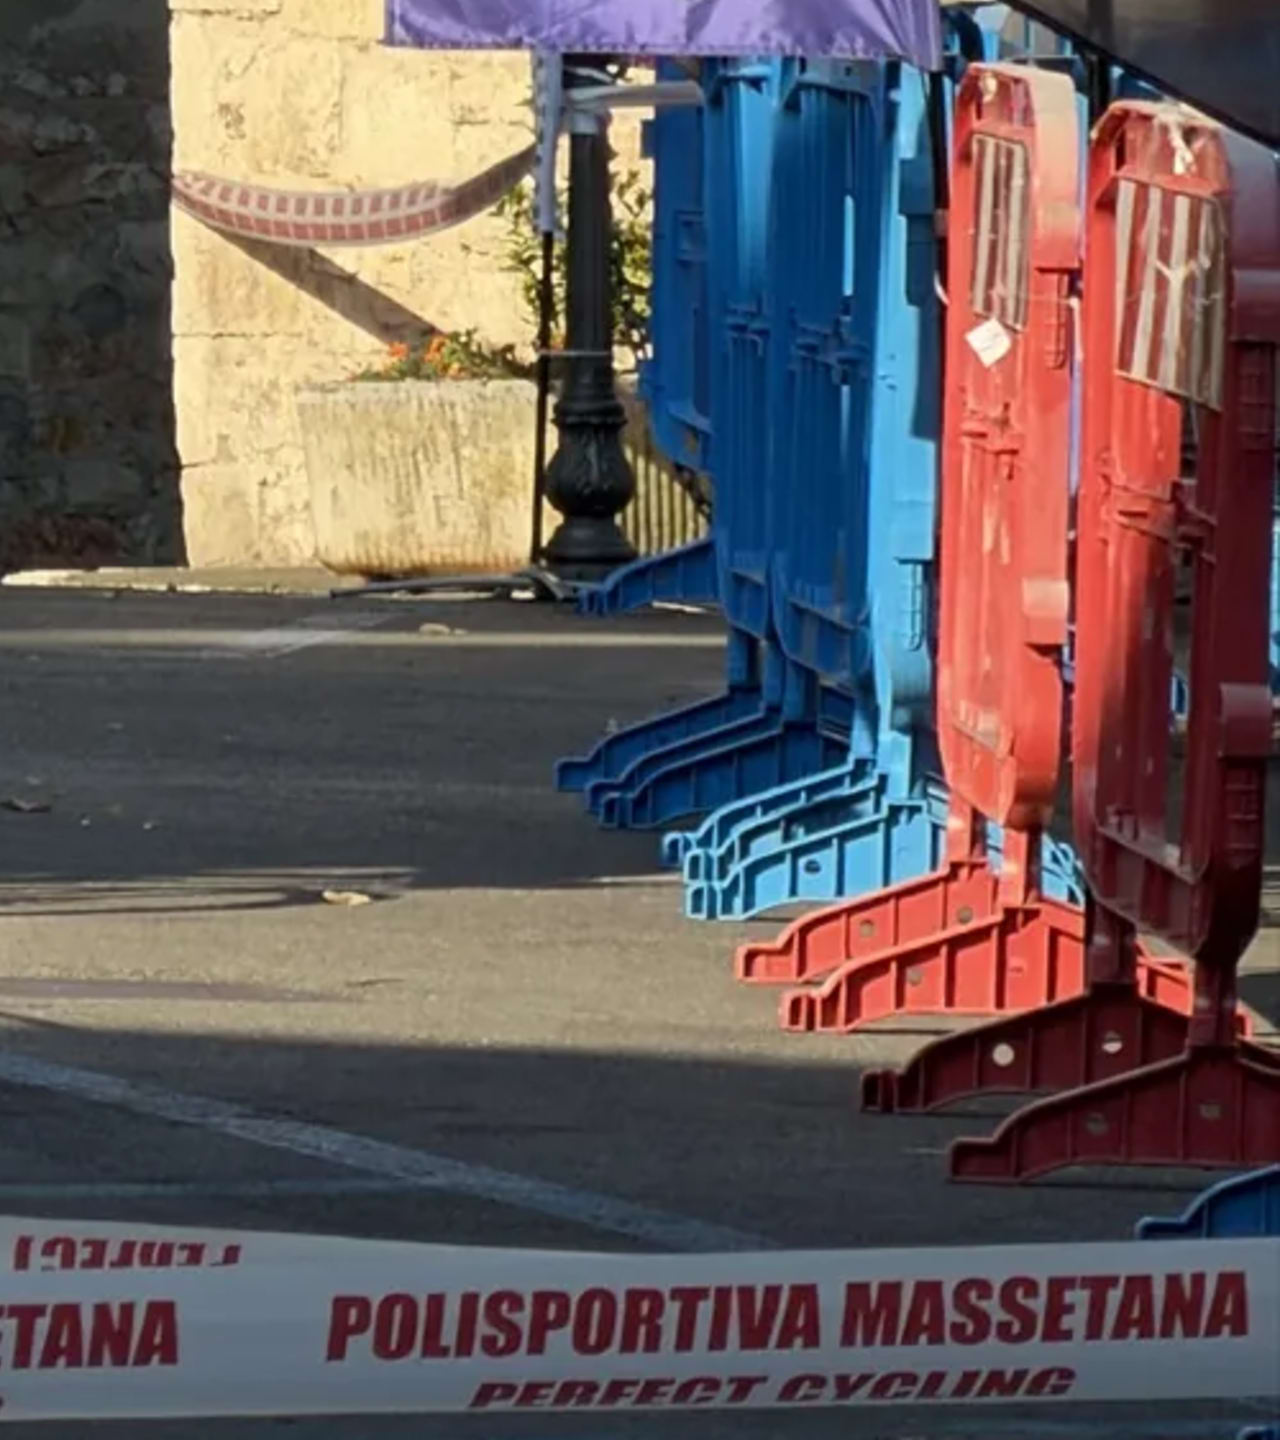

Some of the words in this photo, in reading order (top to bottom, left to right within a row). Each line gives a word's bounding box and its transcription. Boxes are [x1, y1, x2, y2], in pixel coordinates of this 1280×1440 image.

[325, 1282, 822, 1363] POLISPORTIVA
[839, 1270, 1250, 1349] MASSETANA
[468, 1375, 769, 1409] PERFECT
[776, 1366, 1078, 1403] CYCLING
